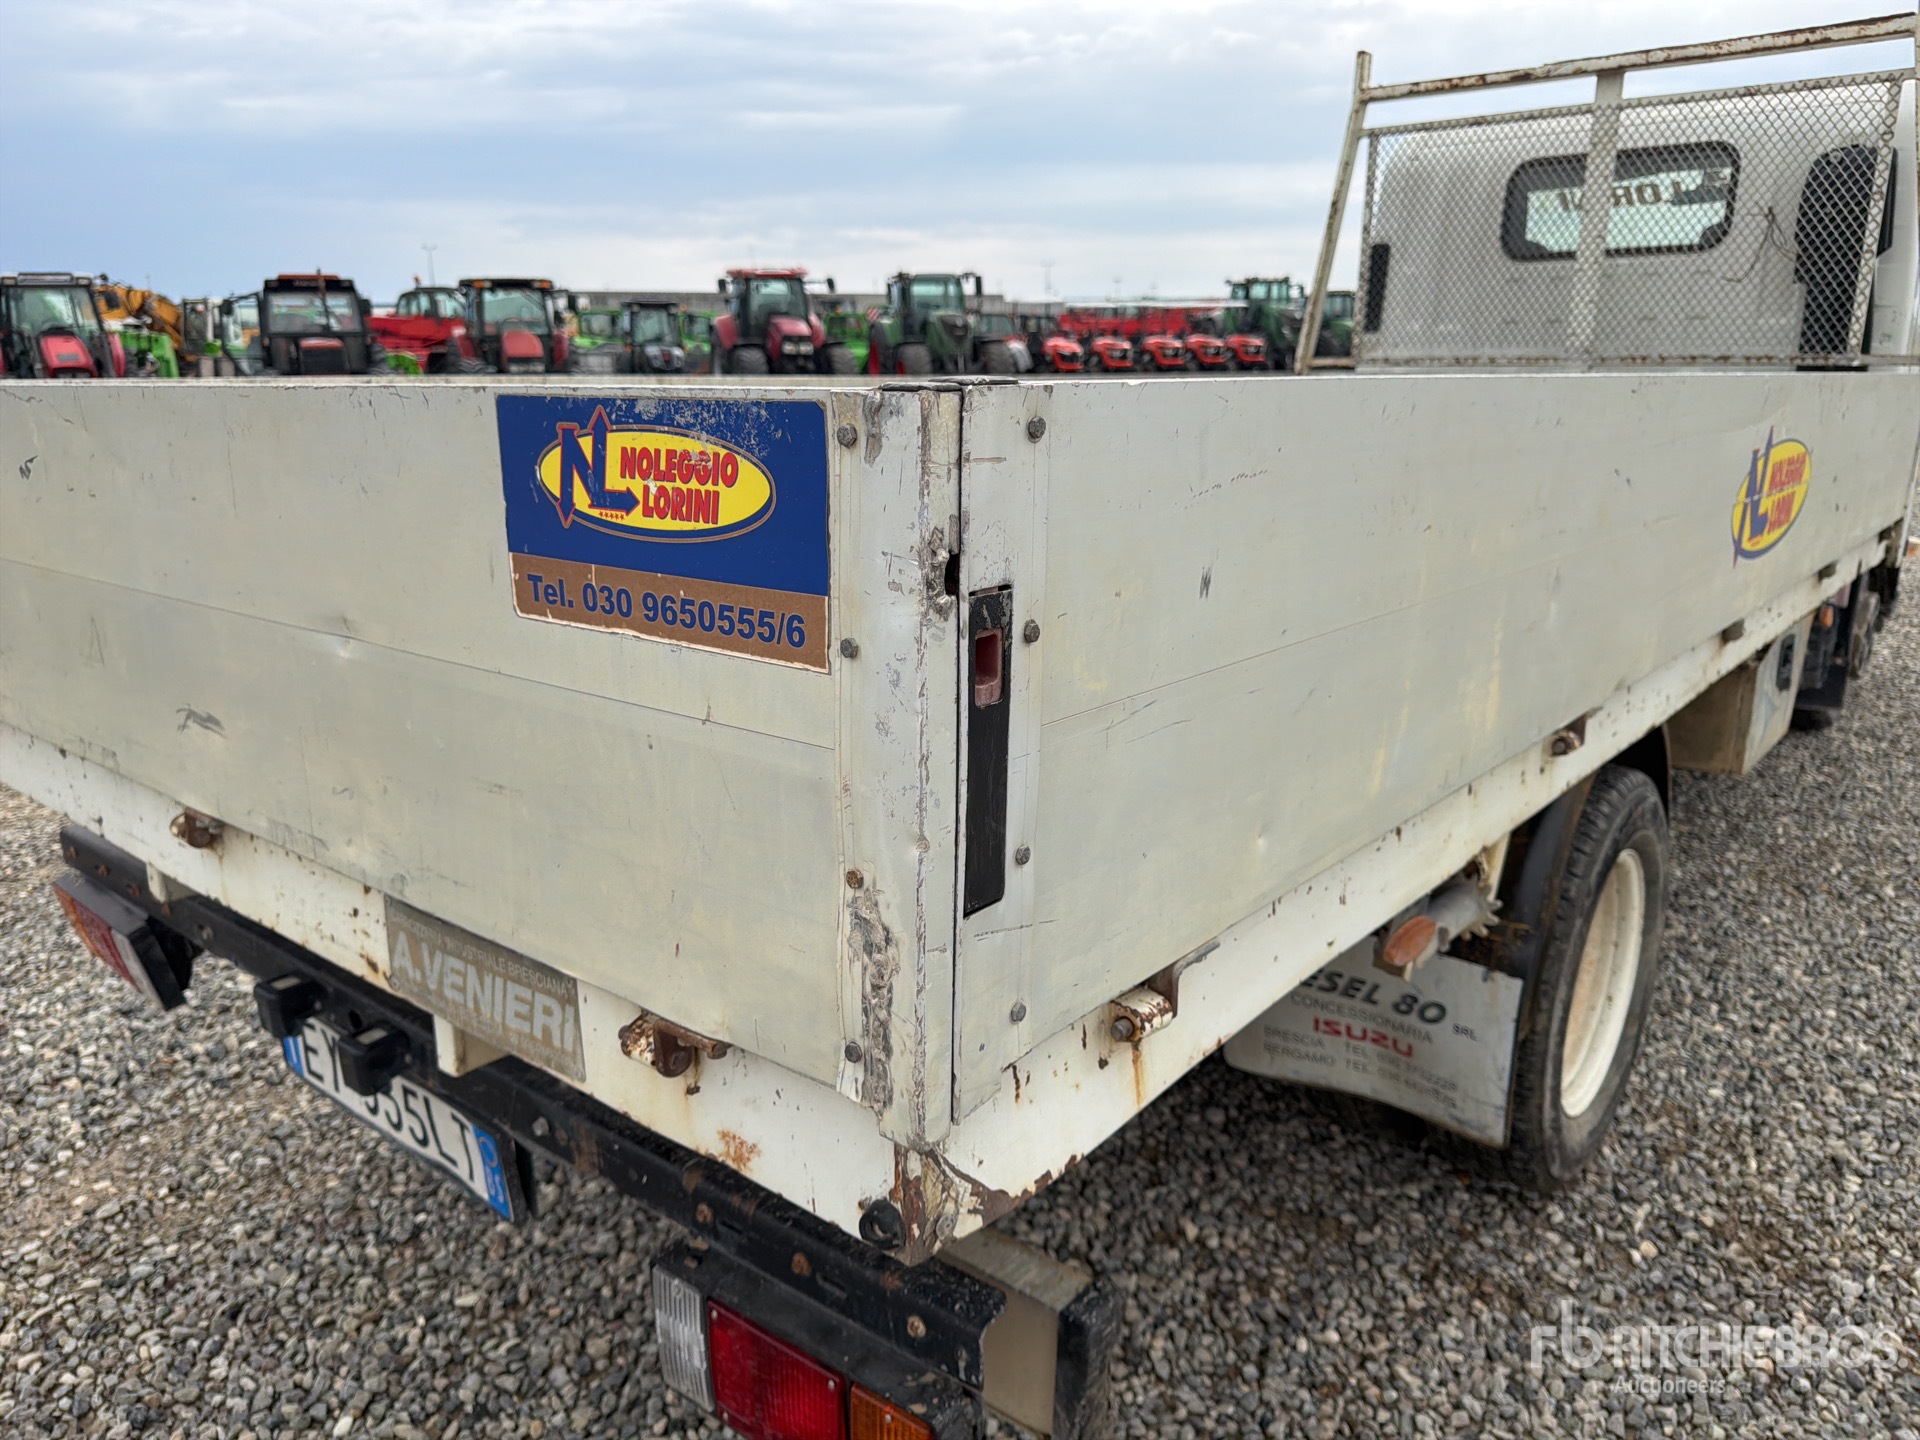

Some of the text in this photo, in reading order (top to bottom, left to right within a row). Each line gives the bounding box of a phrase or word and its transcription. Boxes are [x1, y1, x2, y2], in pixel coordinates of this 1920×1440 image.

[619, 446, 739, 488] NOLEGGIO
[641, 483, 720, 525] LORINI
[527, 573, 806, 649] Tel. 030 9650555/6
[392, 930, 575, 1053] A.VENIERI
[507, 960, 569, 998] BRESCIANA
[1290, 991, 1434, 1045] CONCESSIONARIA
[1312, 1016, 1415, 1058] ISUZU
